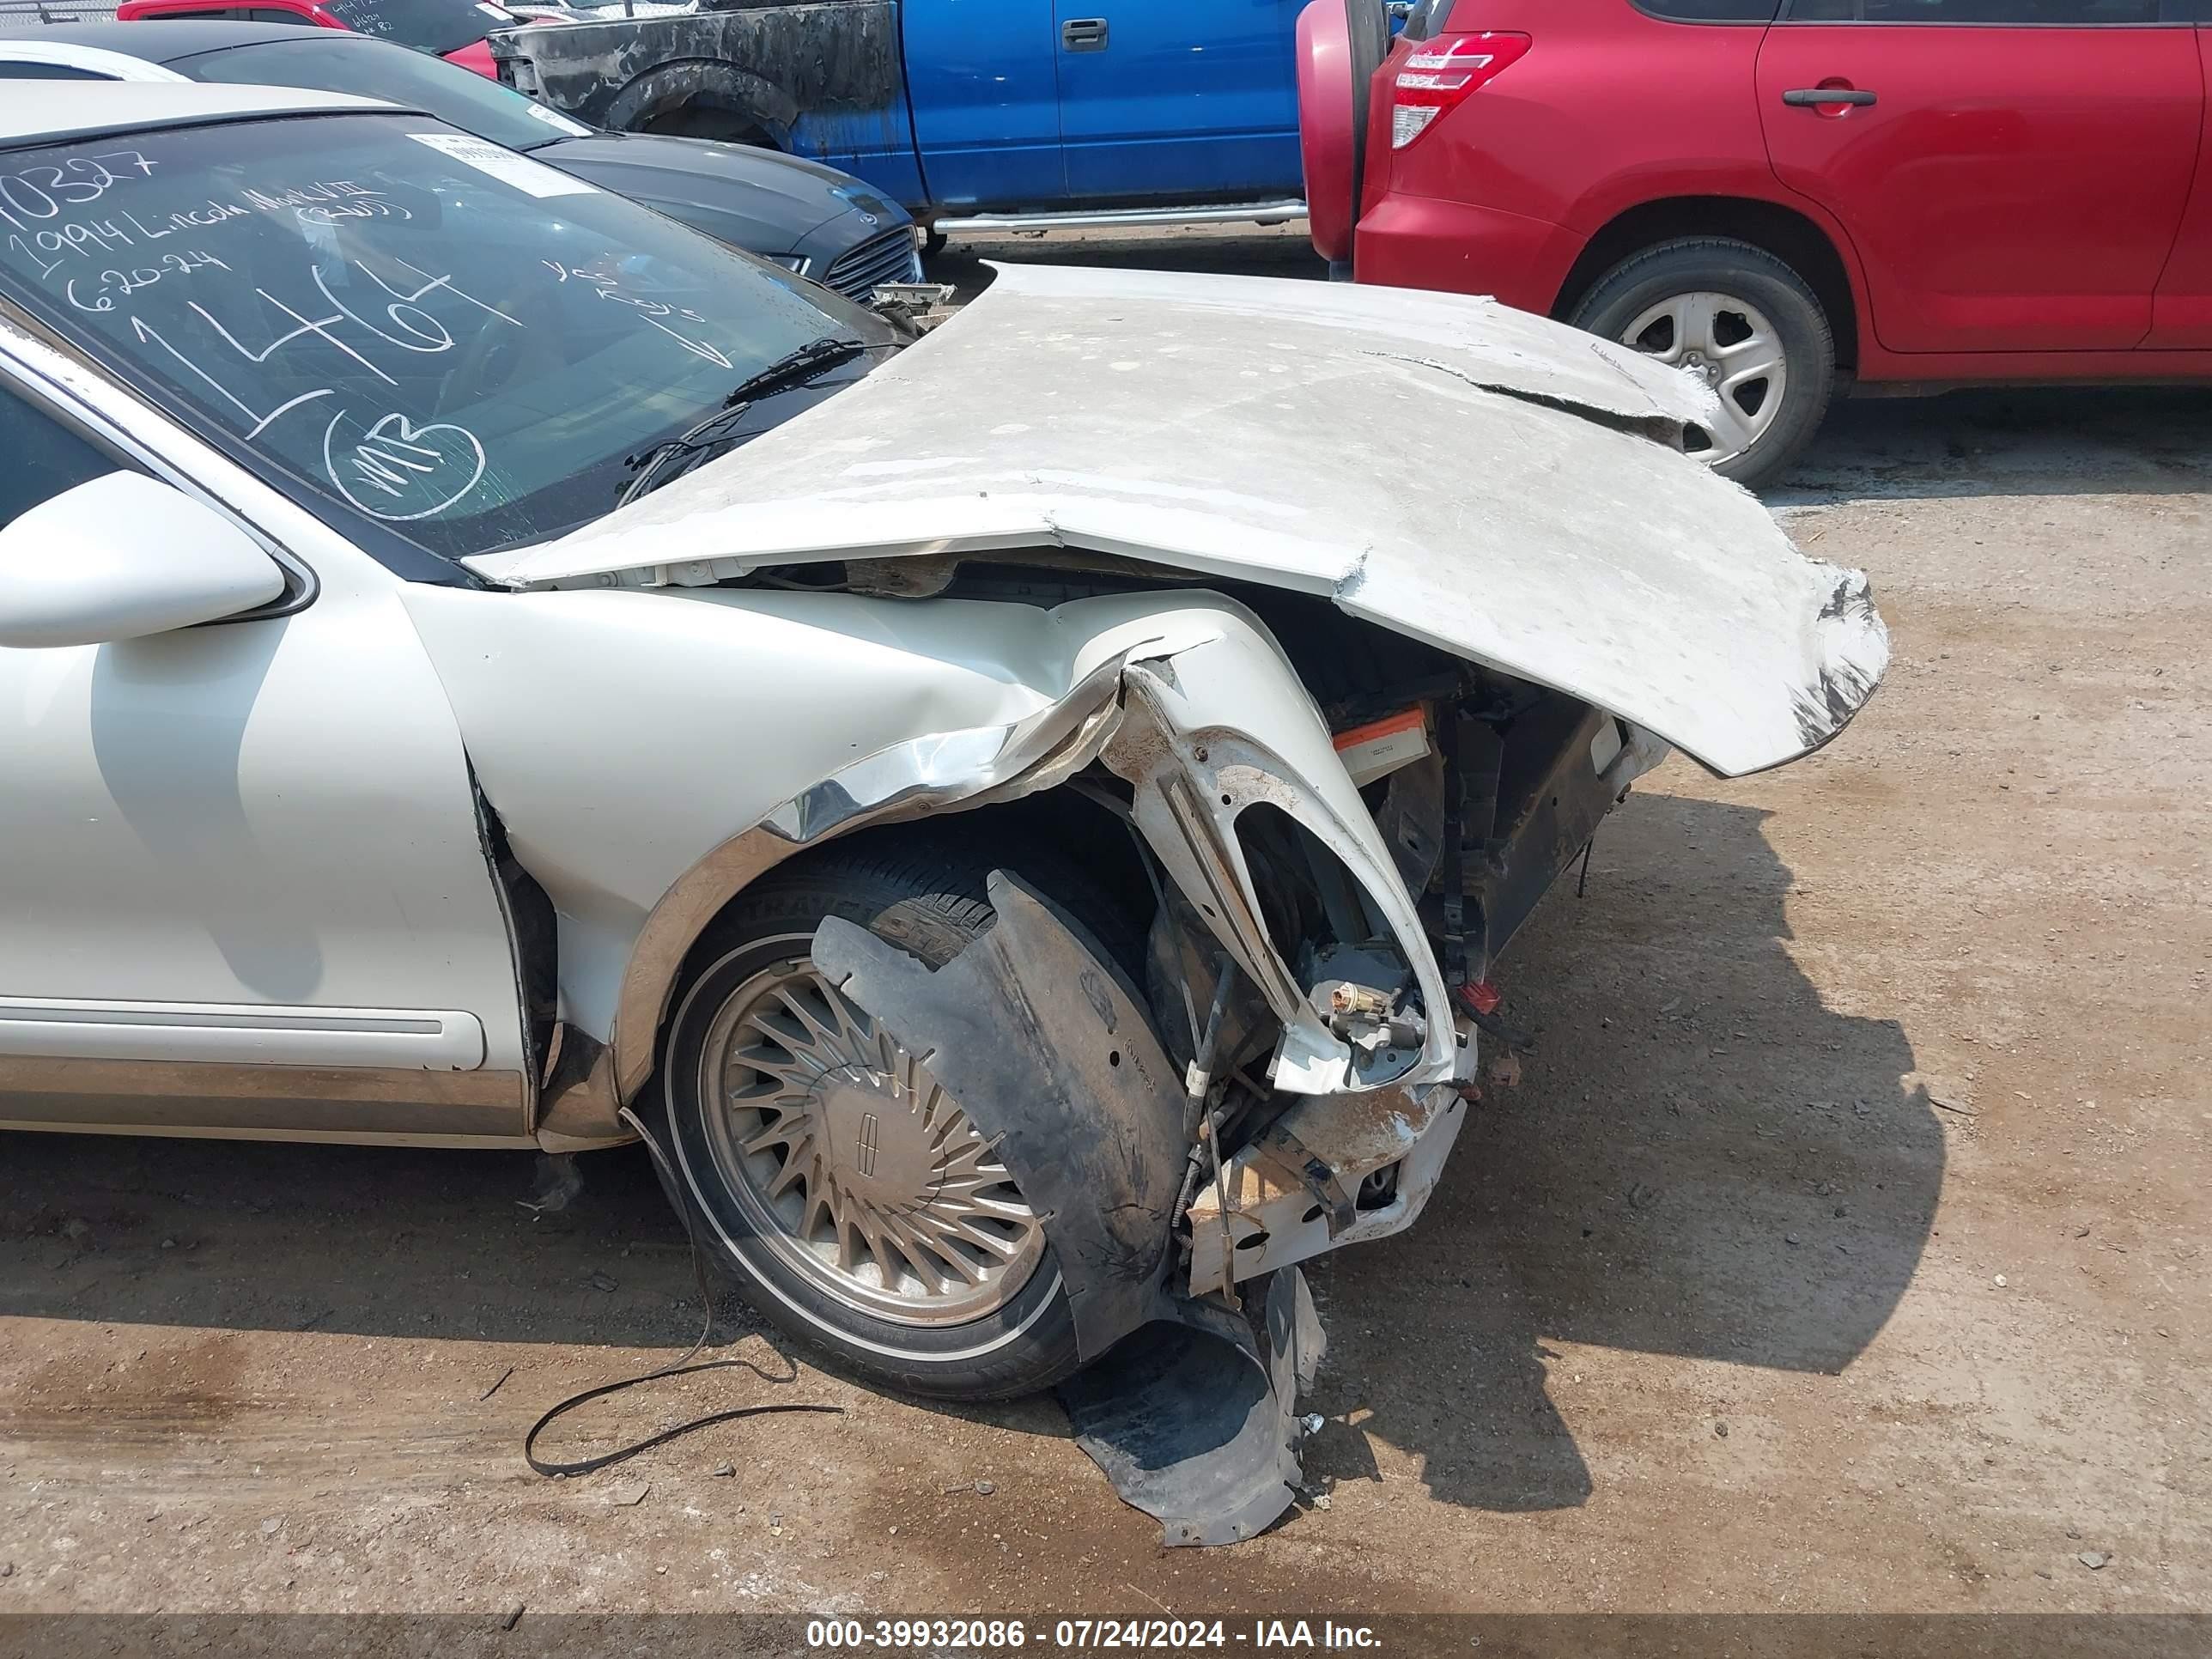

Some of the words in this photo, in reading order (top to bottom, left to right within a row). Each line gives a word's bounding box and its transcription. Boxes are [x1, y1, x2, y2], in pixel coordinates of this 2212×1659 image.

[377, 21, 394, 31] 82
[9, 219, 135, 280] 1994
[67, 251, 233, 312] 6-20-24
[131, 257, 527, 441] 1464
